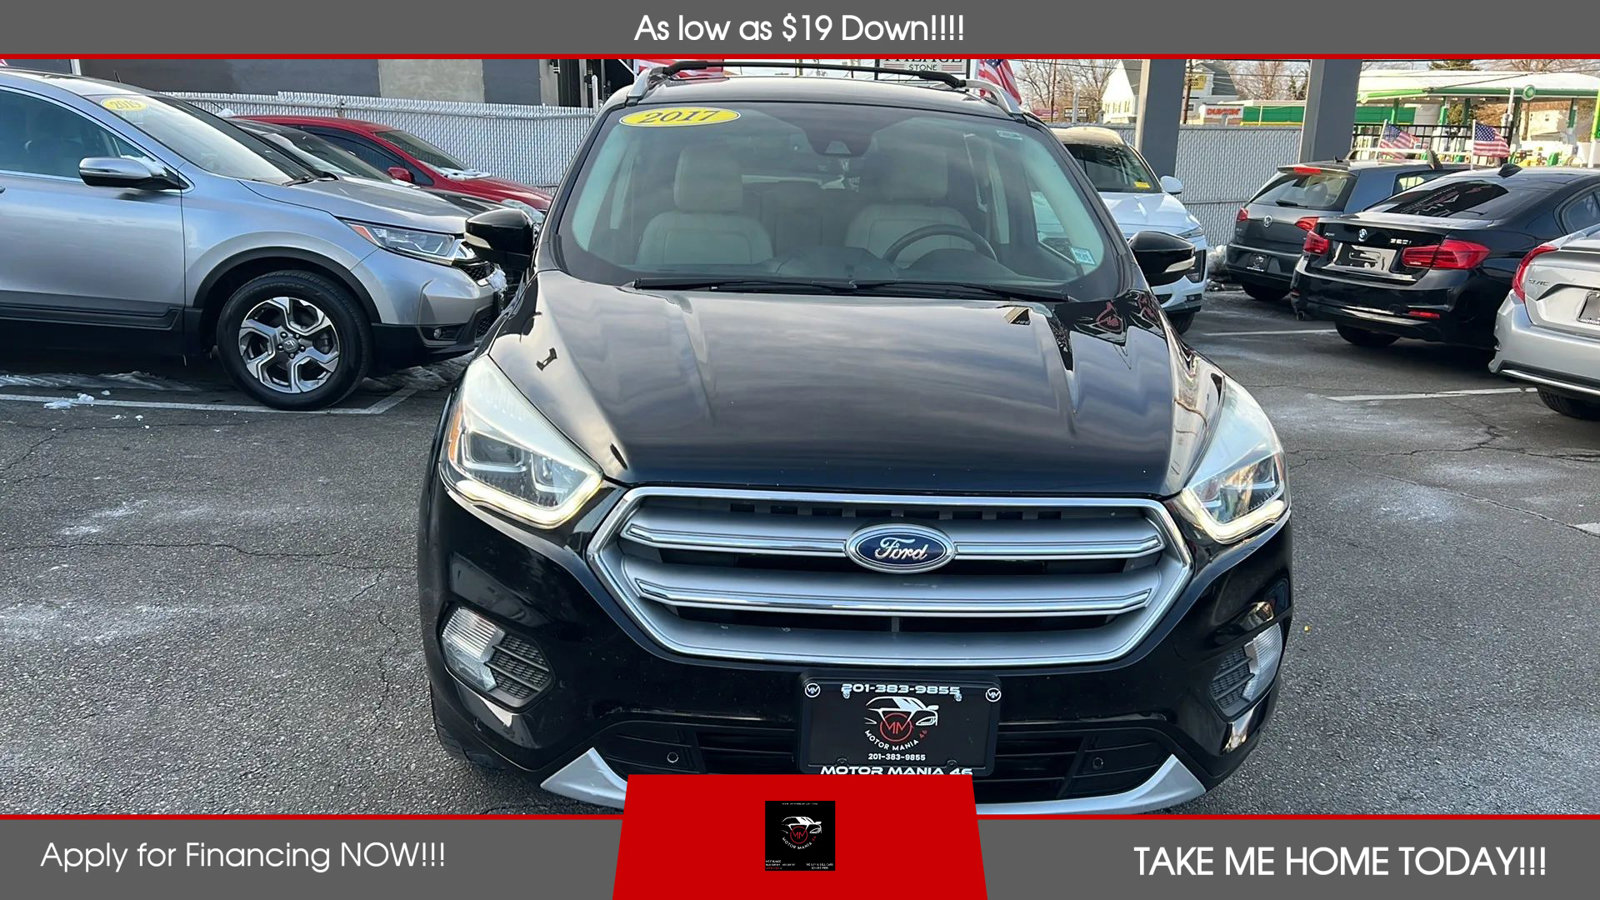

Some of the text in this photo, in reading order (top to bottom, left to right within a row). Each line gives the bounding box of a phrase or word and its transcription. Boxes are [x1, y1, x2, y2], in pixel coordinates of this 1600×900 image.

[638, 110, 720, 124] 2017
[874, 537, 929, 560] Ford
[841, 683, 961, 696] 201-383-9855
[865, 729, 890, 751] MOTOR
[892, 739, 919, 751] MANIA
[868, 753, 926, 762] 201-383-9855
[820, 766, 884, 775] MOTOR
[888, 766, 944, 775] MANIA
